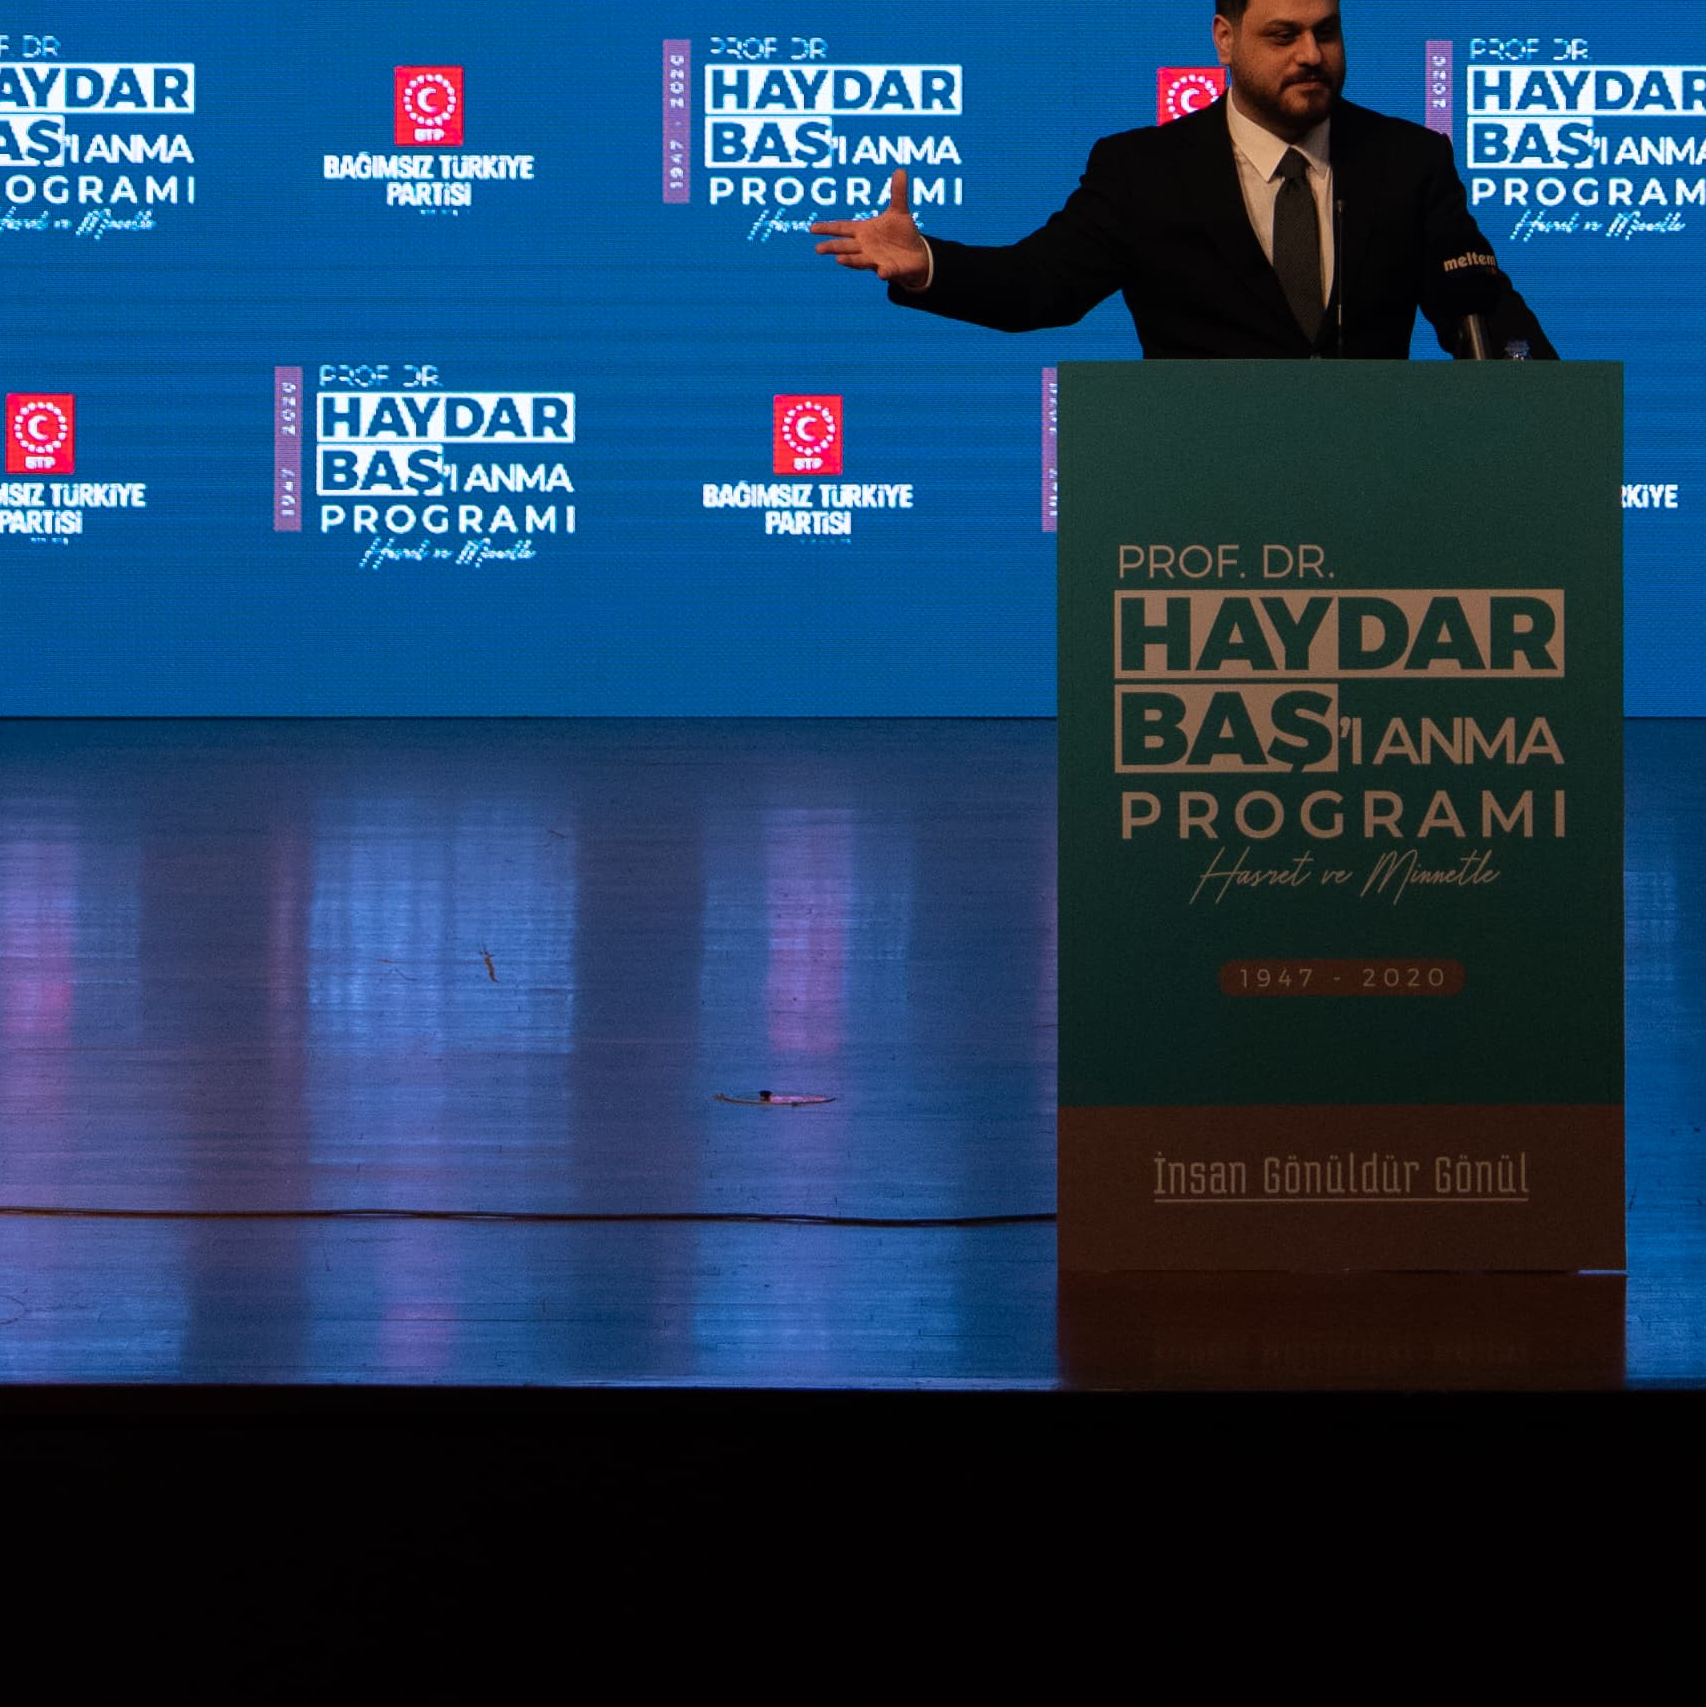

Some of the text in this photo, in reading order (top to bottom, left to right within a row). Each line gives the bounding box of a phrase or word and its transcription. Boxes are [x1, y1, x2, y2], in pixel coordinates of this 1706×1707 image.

[711, 69, 956, 110] HAYDAR
[84, 135, 193, 163] ANMA
[853, 136, 960, 164] ANMA
[1443, 251, 1497, 273] meltem
[322, 397, 568, 438] HAYDAR
[465, 464, 573, 492] ANMA
[322, 505, 574, 533] PROGRAMI
[1118, 544, 1335, 580] PROF. DR.
[1121, 596, 1558, 671] HAYDAR
[1377, 716, 1565, 765] ANMA
[1121, 789, 1566, 840] PROGRAMI
[1189, 846, 1501, 906] Hasret ve Minnetle
[1239, 968, 1314, 988] 1947
[1362, 968, 1446, 988] 2020
[1154, 1151, 1530, 1195] İnsan Gönüldür Gönül
